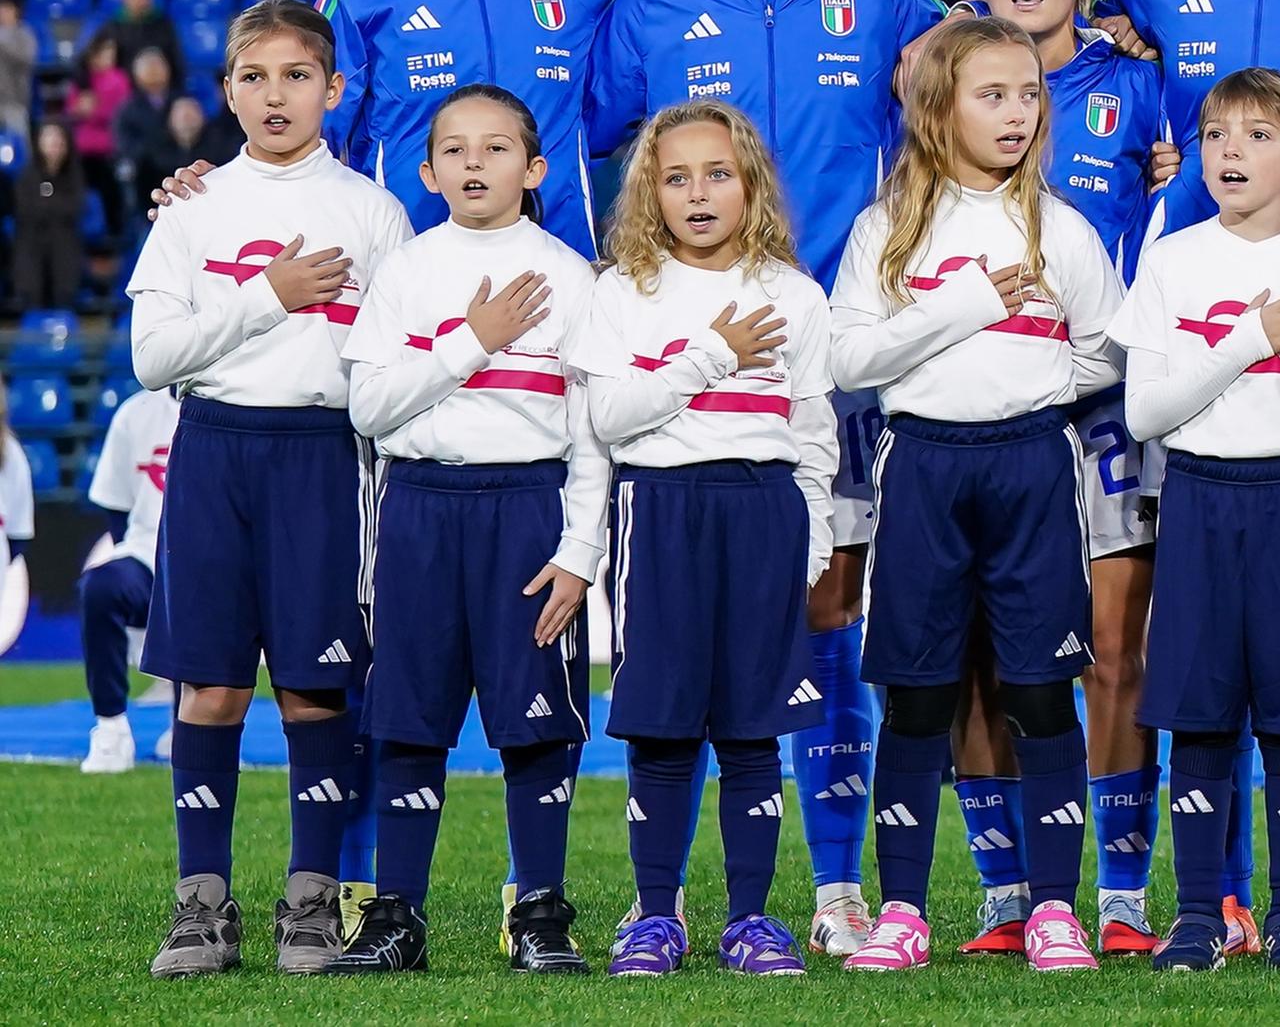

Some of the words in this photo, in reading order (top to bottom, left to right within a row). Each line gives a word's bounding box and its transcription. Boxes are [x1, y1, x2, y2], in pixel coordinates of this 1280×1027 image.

[542, 47, 570, 57] Telepass
[1191, 41, 1216, 55] TIM
[424, 52, 453, 67] TIM
[824, 53, 860, 63] Telepass
[536, 65, 557, 79] eni
[702, 61, 730, 76] TIM
[1178, 61, 1215, 76] Poste
[409, 72, 456, 88] Poste
[818, 71, 842, 85] eni
[688, 81, 731, 98] Poste
[1092, 96, 1118, 107] ITALIA
[1080, 154, 1114, 169] Telepass
[1069, 174, 1093, 189] eni
[1089, 420, 1140, 496] 2
[808, 741, 872, 757] ITALIA
[1099, 791, 1153, 807] ITALIA
